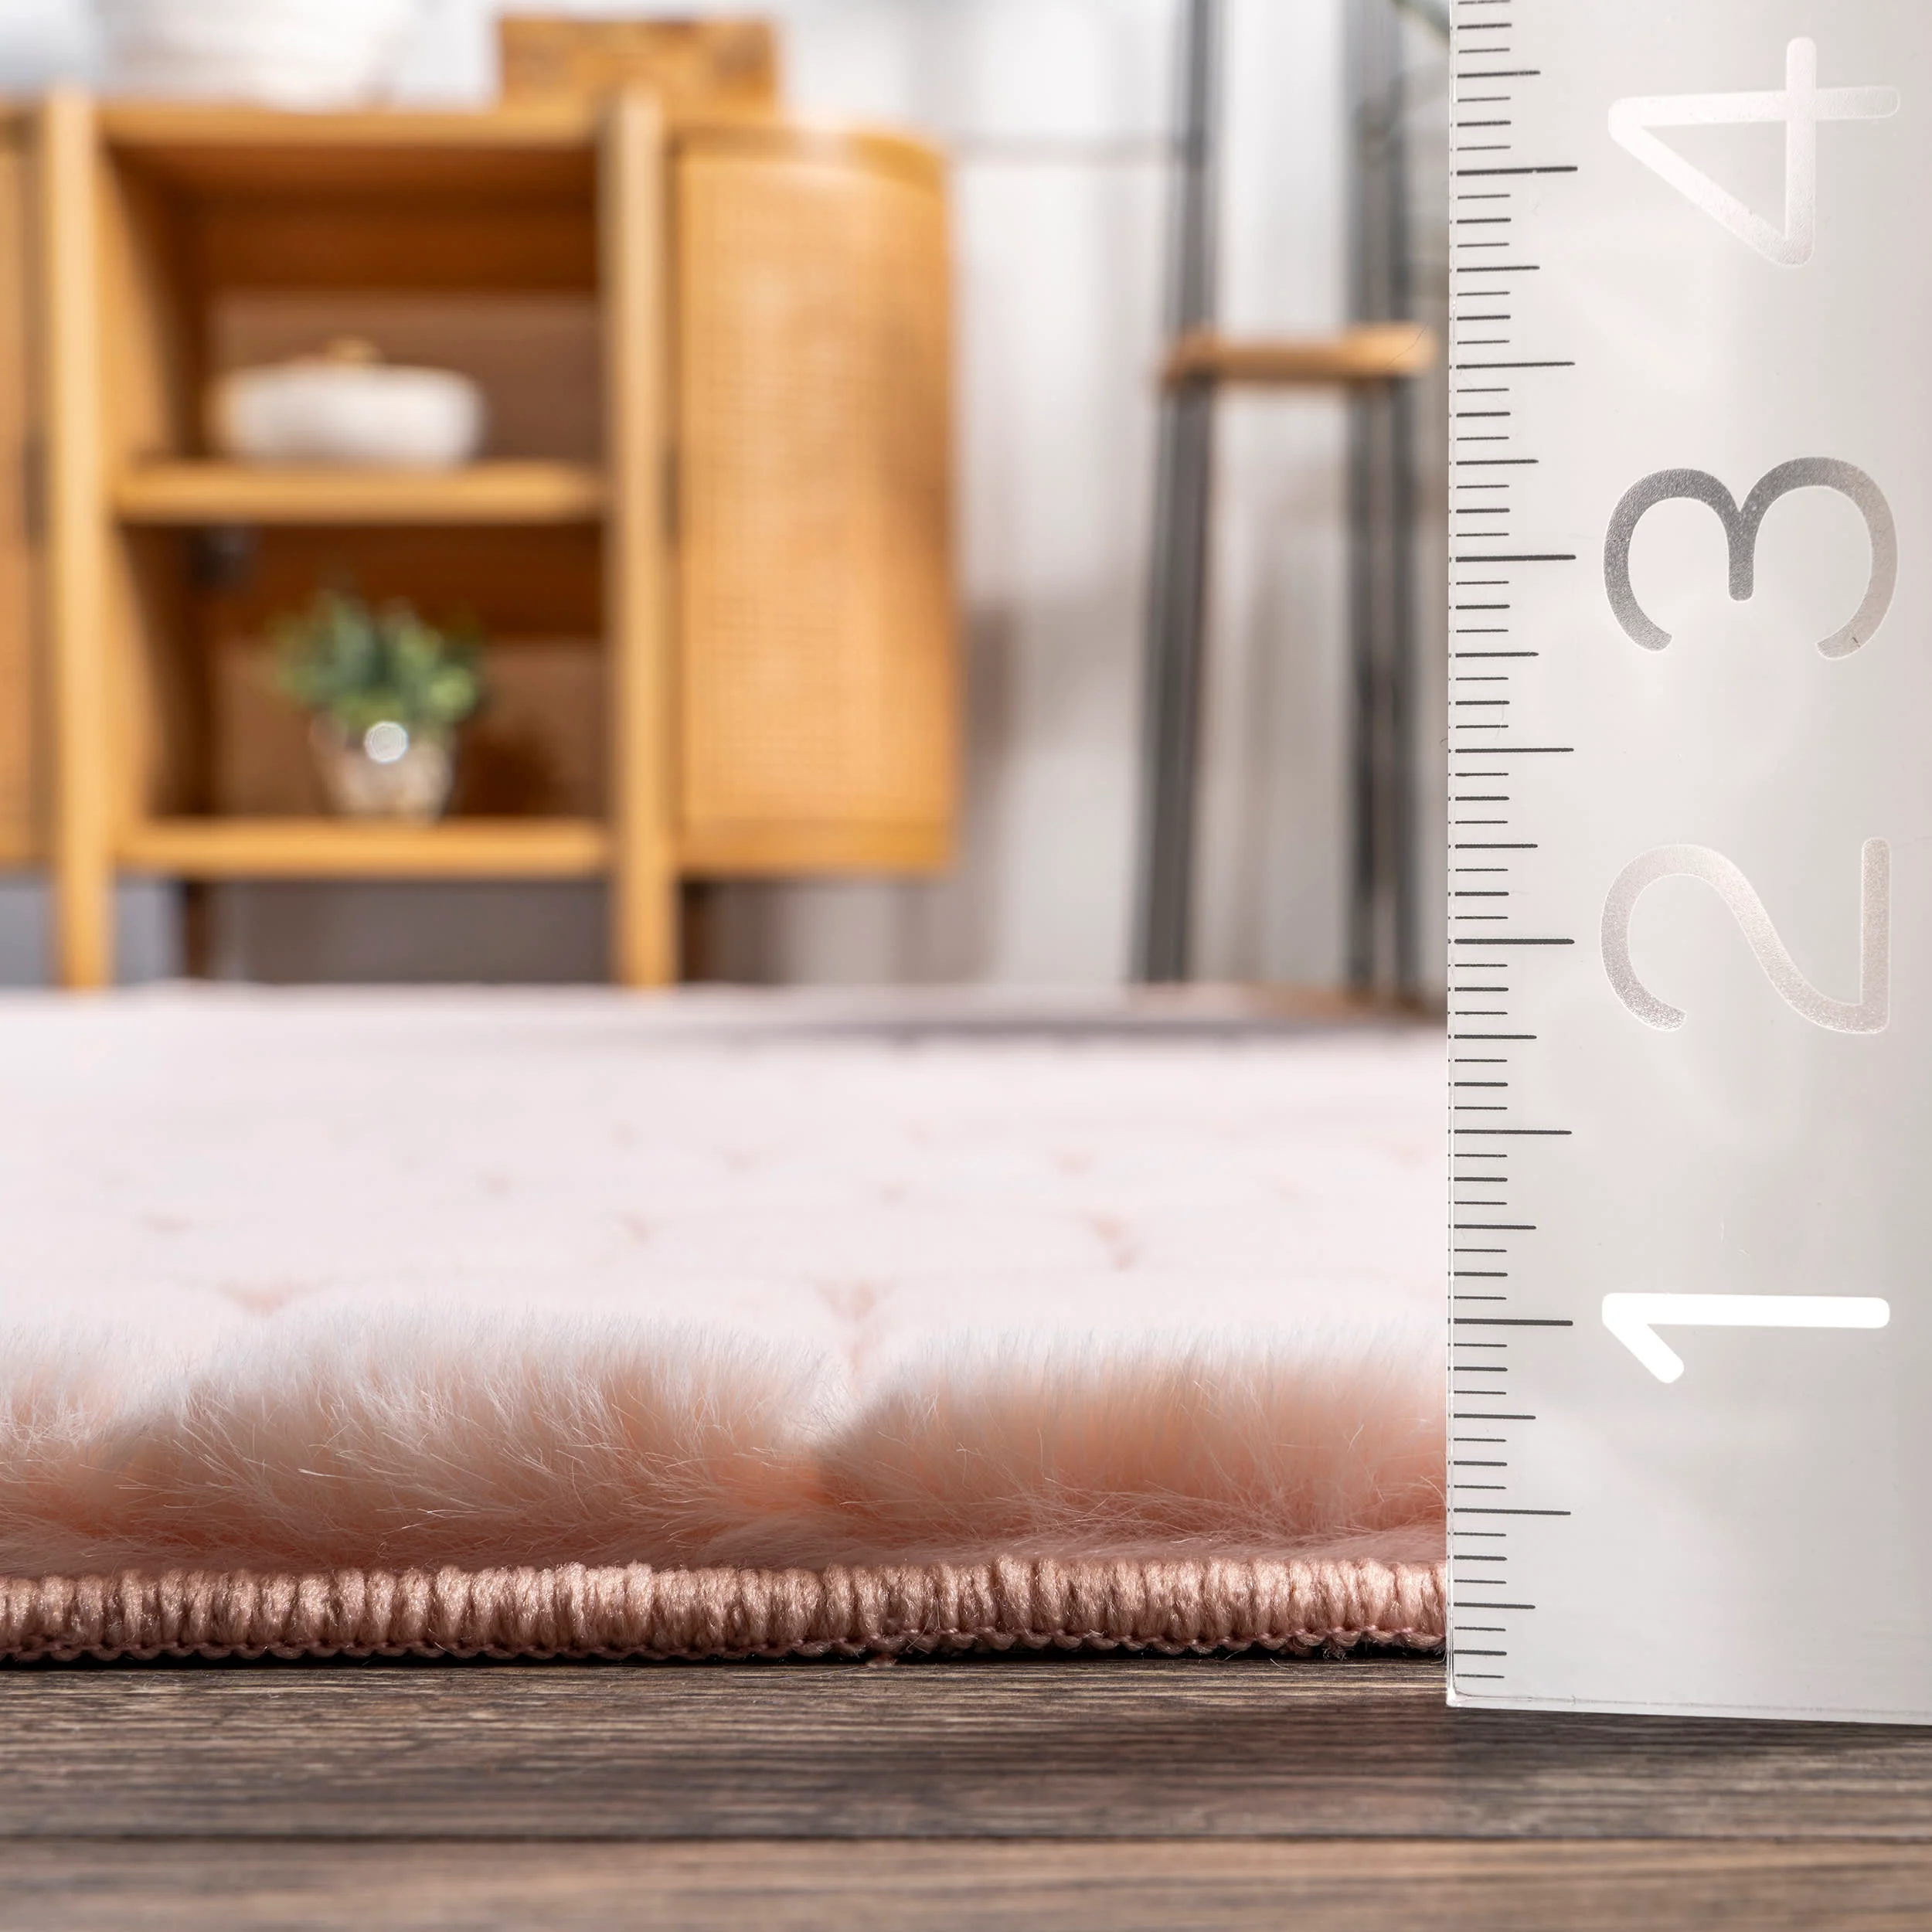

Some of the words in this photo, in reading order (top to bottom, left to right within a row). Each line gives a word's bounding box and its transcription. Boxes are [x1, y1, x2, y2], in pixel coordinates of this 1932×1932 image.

[1608, 36, 1900, 267] 4
[1603, 457, 1897, 659] 3
[1600, 836, 1891, 1035] 2
[1601, 1293, 1890, 1384] 1
